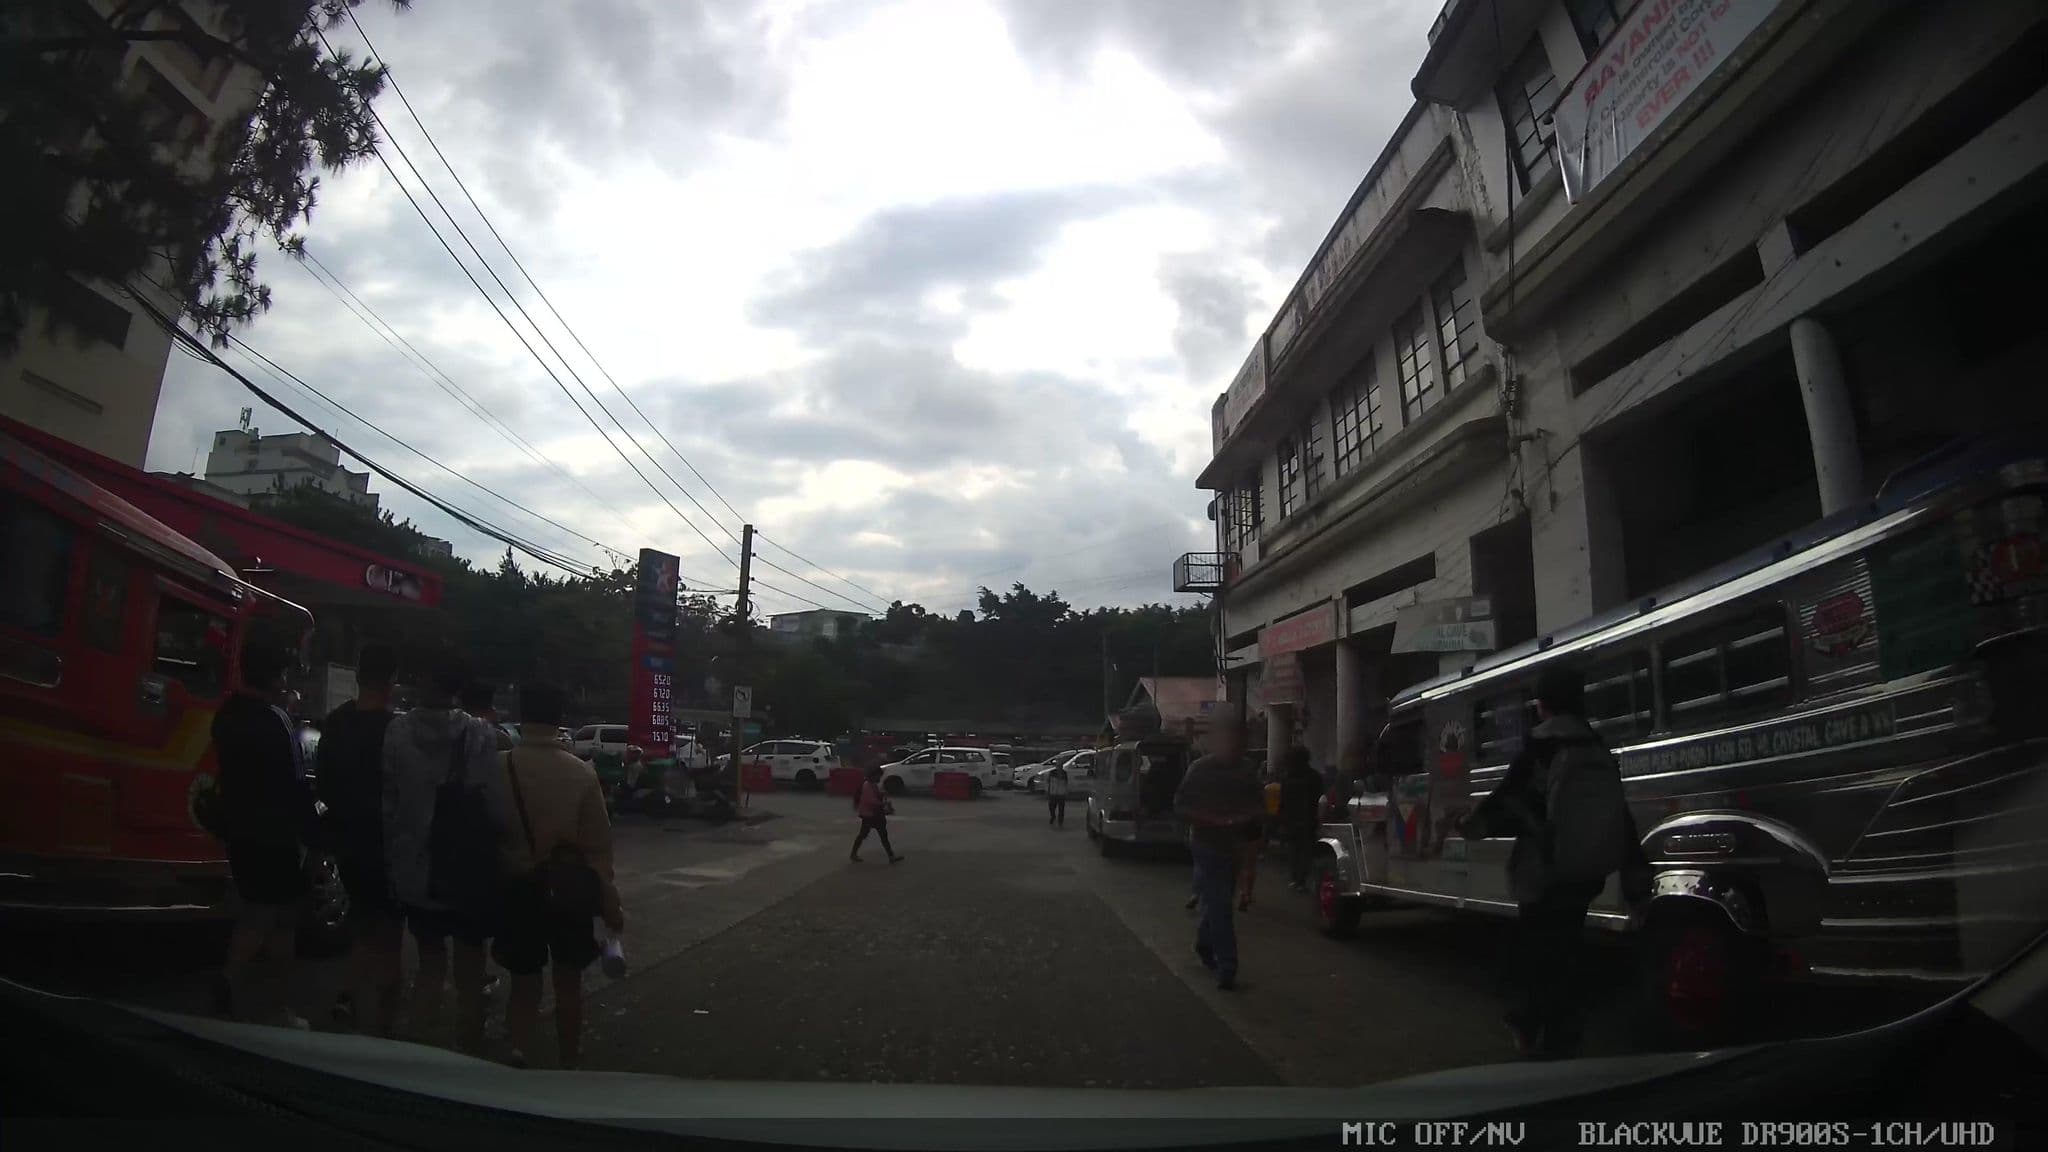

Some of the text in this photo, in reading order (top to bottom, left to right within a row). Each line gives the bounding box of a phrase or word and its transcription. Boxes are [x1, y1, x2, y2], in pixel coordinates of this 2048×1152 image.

[1584, 0, 1680, 108] BAYANI
[1632, 14, 1675, 69] owned
[1675, 22, 1708, 57] NOT
[1635, 66, 1692, 129] EVER
